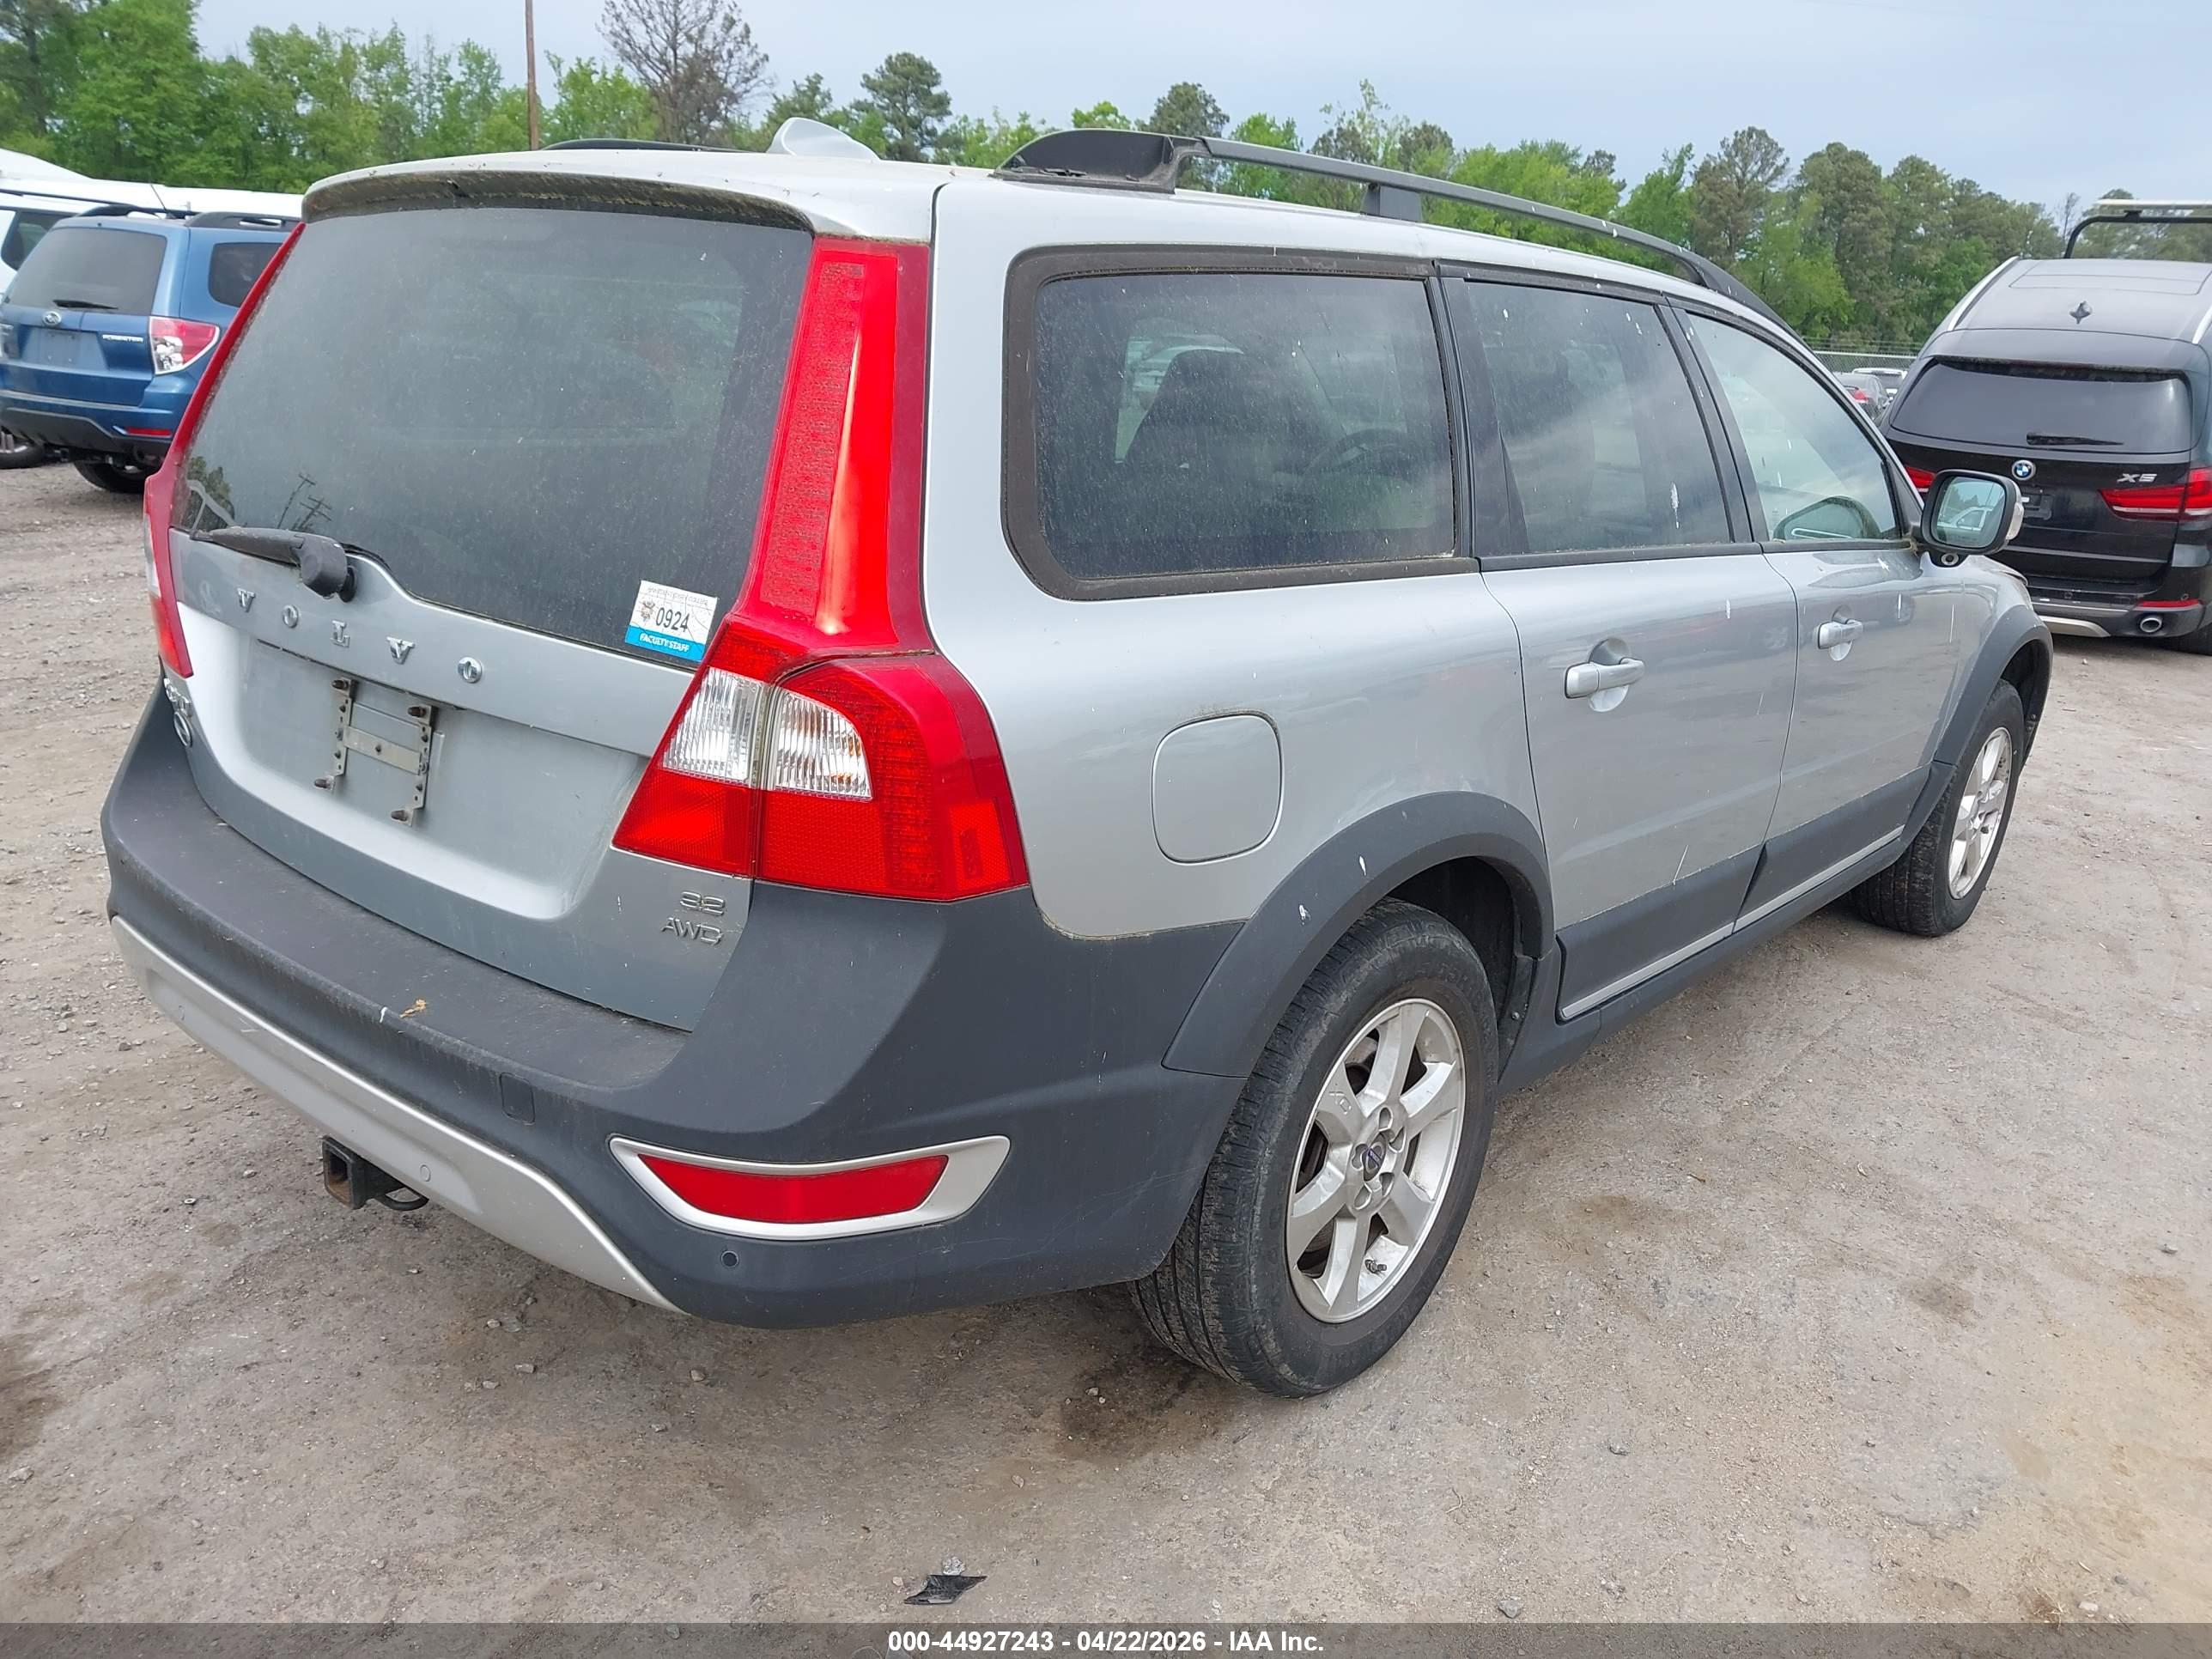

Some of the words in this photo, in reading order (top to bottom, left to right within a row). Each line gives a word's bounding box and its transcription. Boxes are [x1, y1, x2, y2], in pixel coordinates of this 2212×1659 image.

[2117, 473, 2158, 483] X5
[655, 606, 690, 633] 0924
[236, 587, 483, 684] VOLVO
[661, 915, 722, 945] AWD
